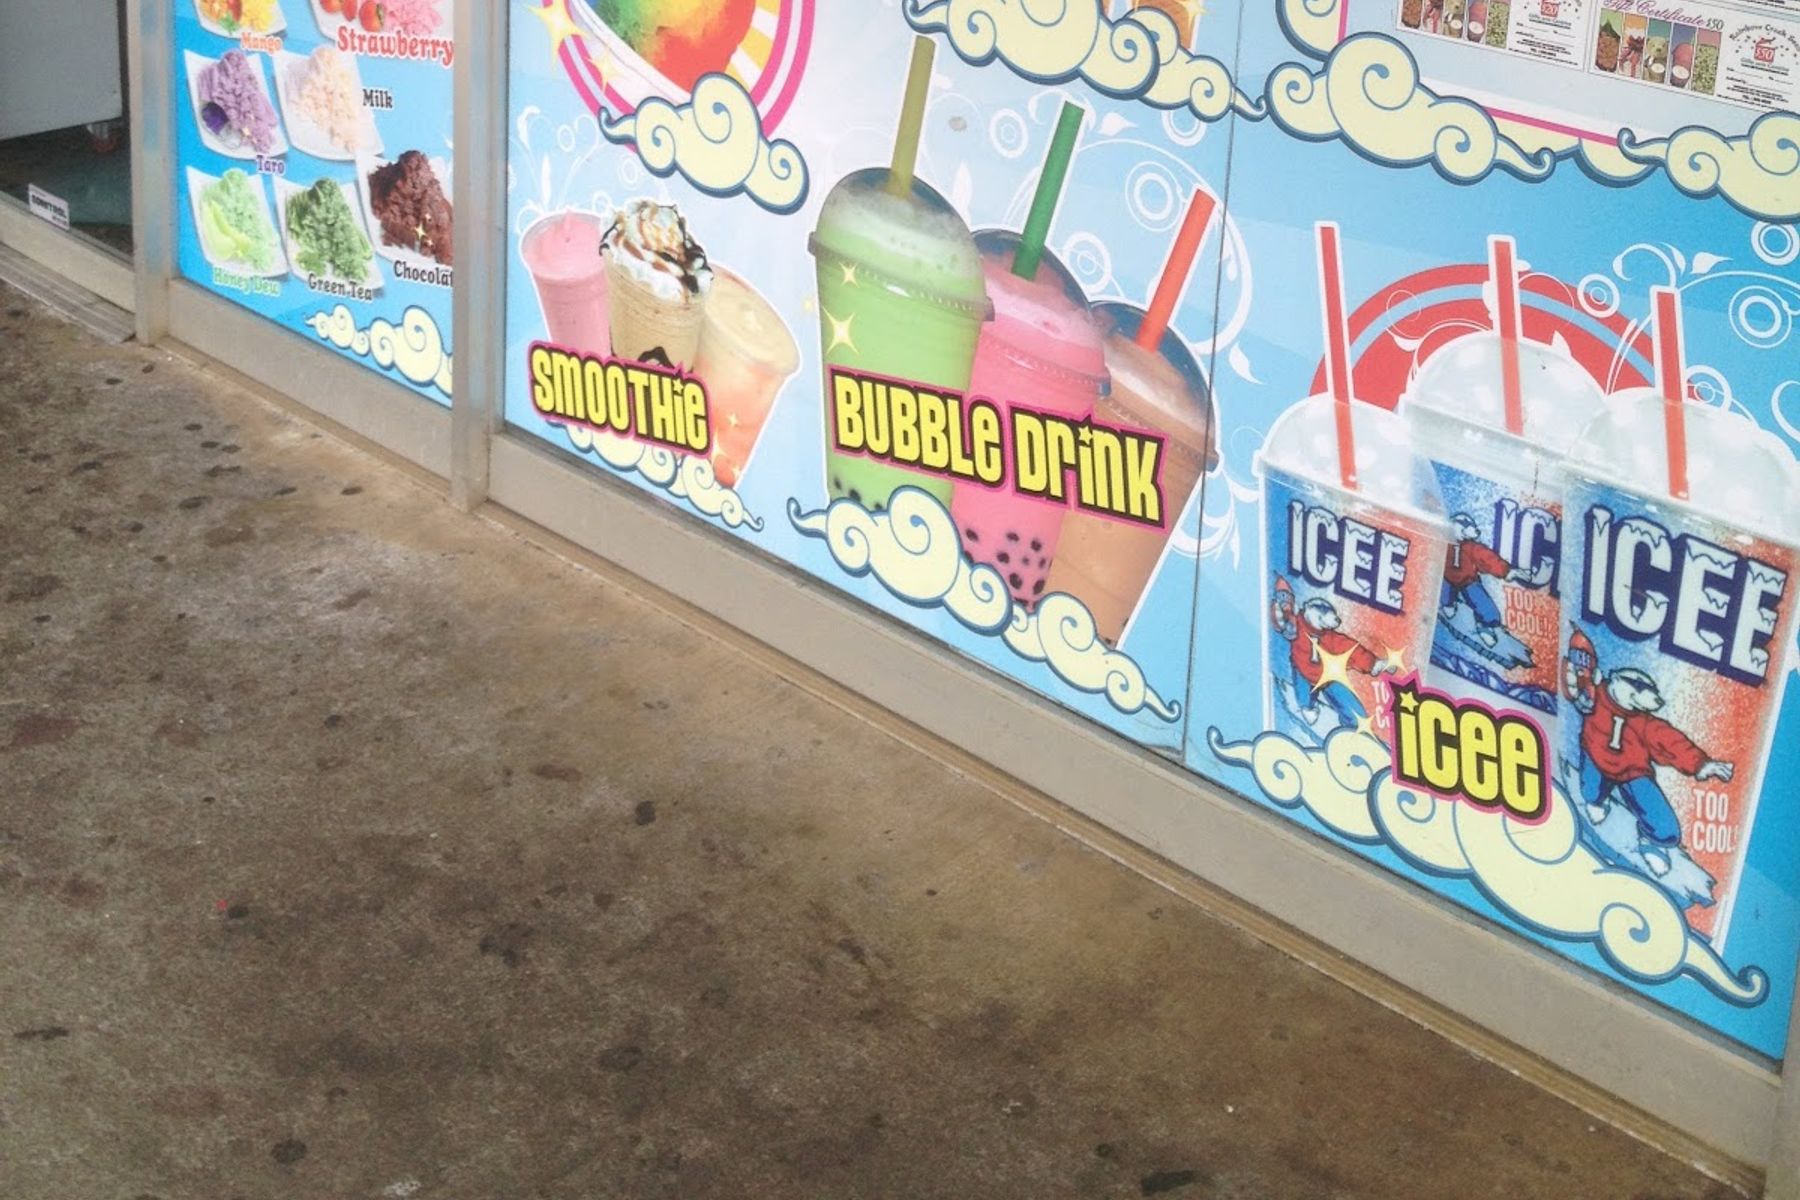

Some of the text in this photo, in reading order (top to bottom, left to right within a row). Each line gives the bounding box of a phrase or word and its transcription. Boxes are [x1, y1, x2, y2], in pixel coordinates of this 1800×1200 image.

[241, 32, 282, 52] Mango
[337, 25, 455, 66] Strawberry
[362, 88, 393, 108] Milk
[256, 154, 285, 173] Taro
[308, 273, 373, 300] Green Tea
[1289, 500, 1411, 615] ICEE
[1504, 586, 1534, 611] TOO
[1583, 504, 1789, 684] ICEE
[1692, 788, 1729, 822] TOO
